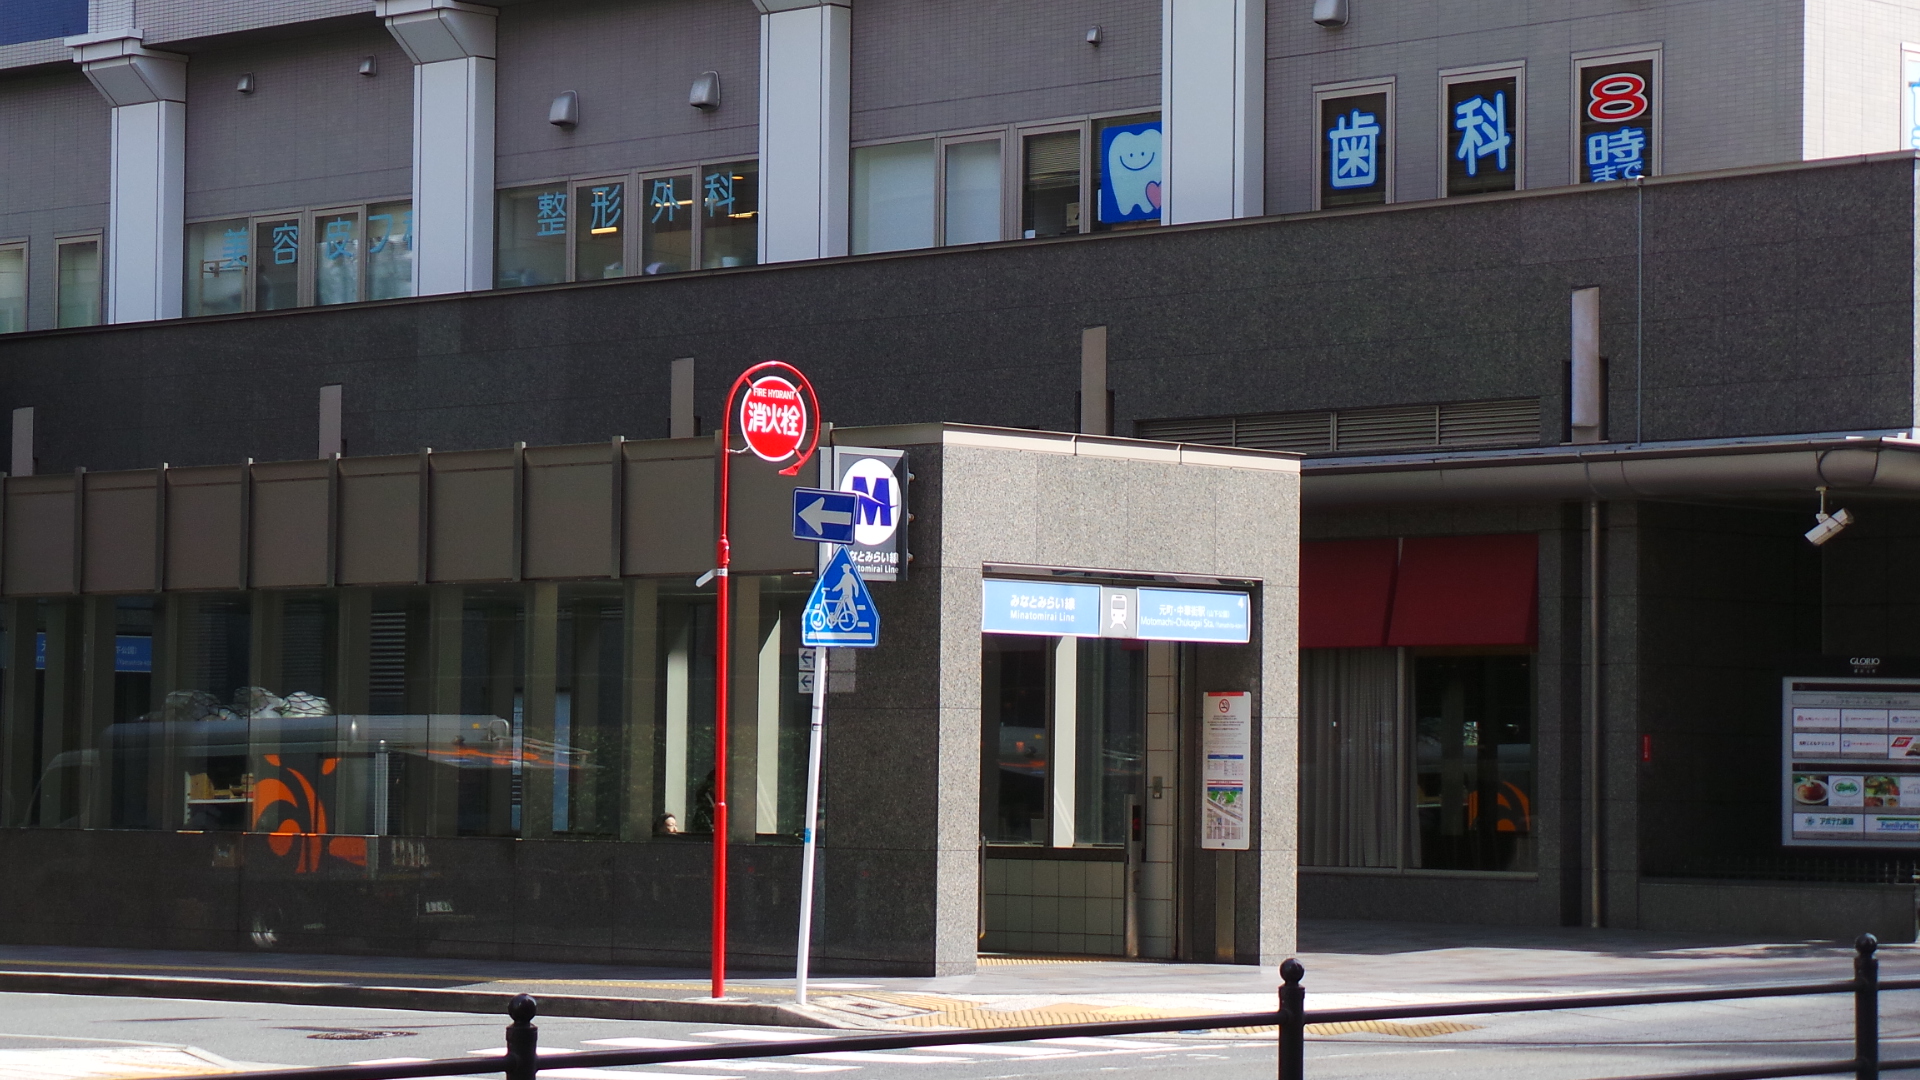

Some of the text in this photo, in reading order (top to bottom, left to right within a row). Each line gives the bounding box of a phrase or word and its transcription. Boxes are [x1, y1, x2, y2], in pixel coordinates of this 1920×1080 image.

[1588, 73, 1647, 122] 8
[1587, 127, 1645, 165] 時
[537, 171, 735, 236] 整形外科
[753, 387, 796, 400] FIRE HYDRANT
[747, 401, 800, 436] 消火栓
[884, 565, 899, 574] Line
[1010, 595, 1076, 611] みなとみらい線
[1237, 597, 1244, 608] 4
[1010, 610, 1075, 622] Minatomirai Line
[1203, 618, 1215, 628] Sta.
[1849, 657, 1881, 665] GLORIO
[1881, 820, 1919, 830] FamilyMart
